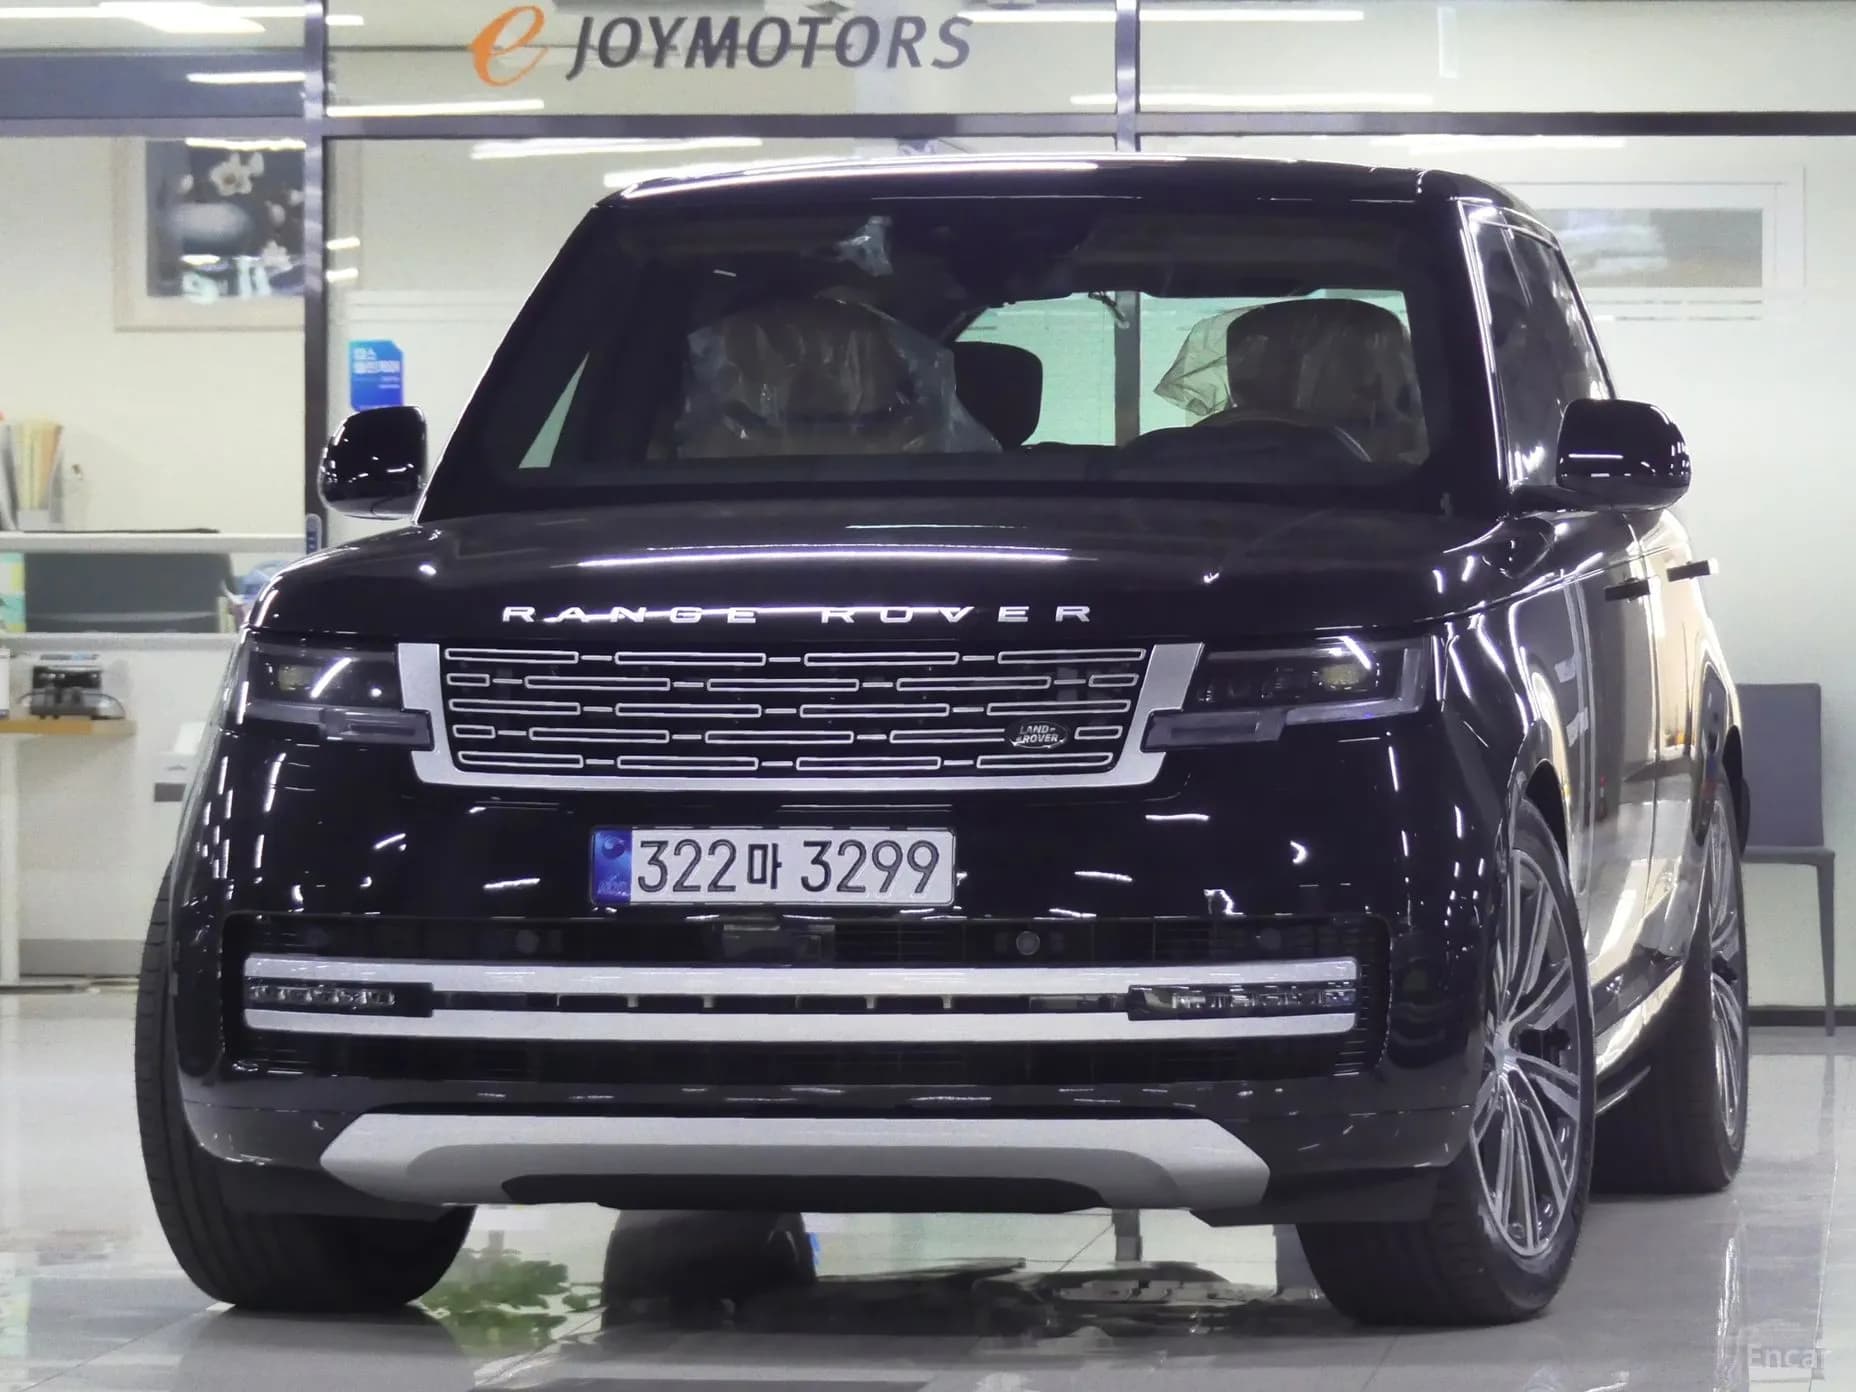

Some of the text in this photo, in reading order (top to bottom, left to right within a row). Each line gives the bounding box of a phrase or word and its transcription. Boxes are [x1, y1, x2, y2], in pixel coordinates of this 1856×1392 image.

[565, 15, 974, 81] JOYMOTORS
[502, 605, 1091, 624] RANGE ROVER
[1023, 734, 1059, 744] ROVER
[637, 839, 783, 894] 322마
[800, 839, 940, 895] 3299
